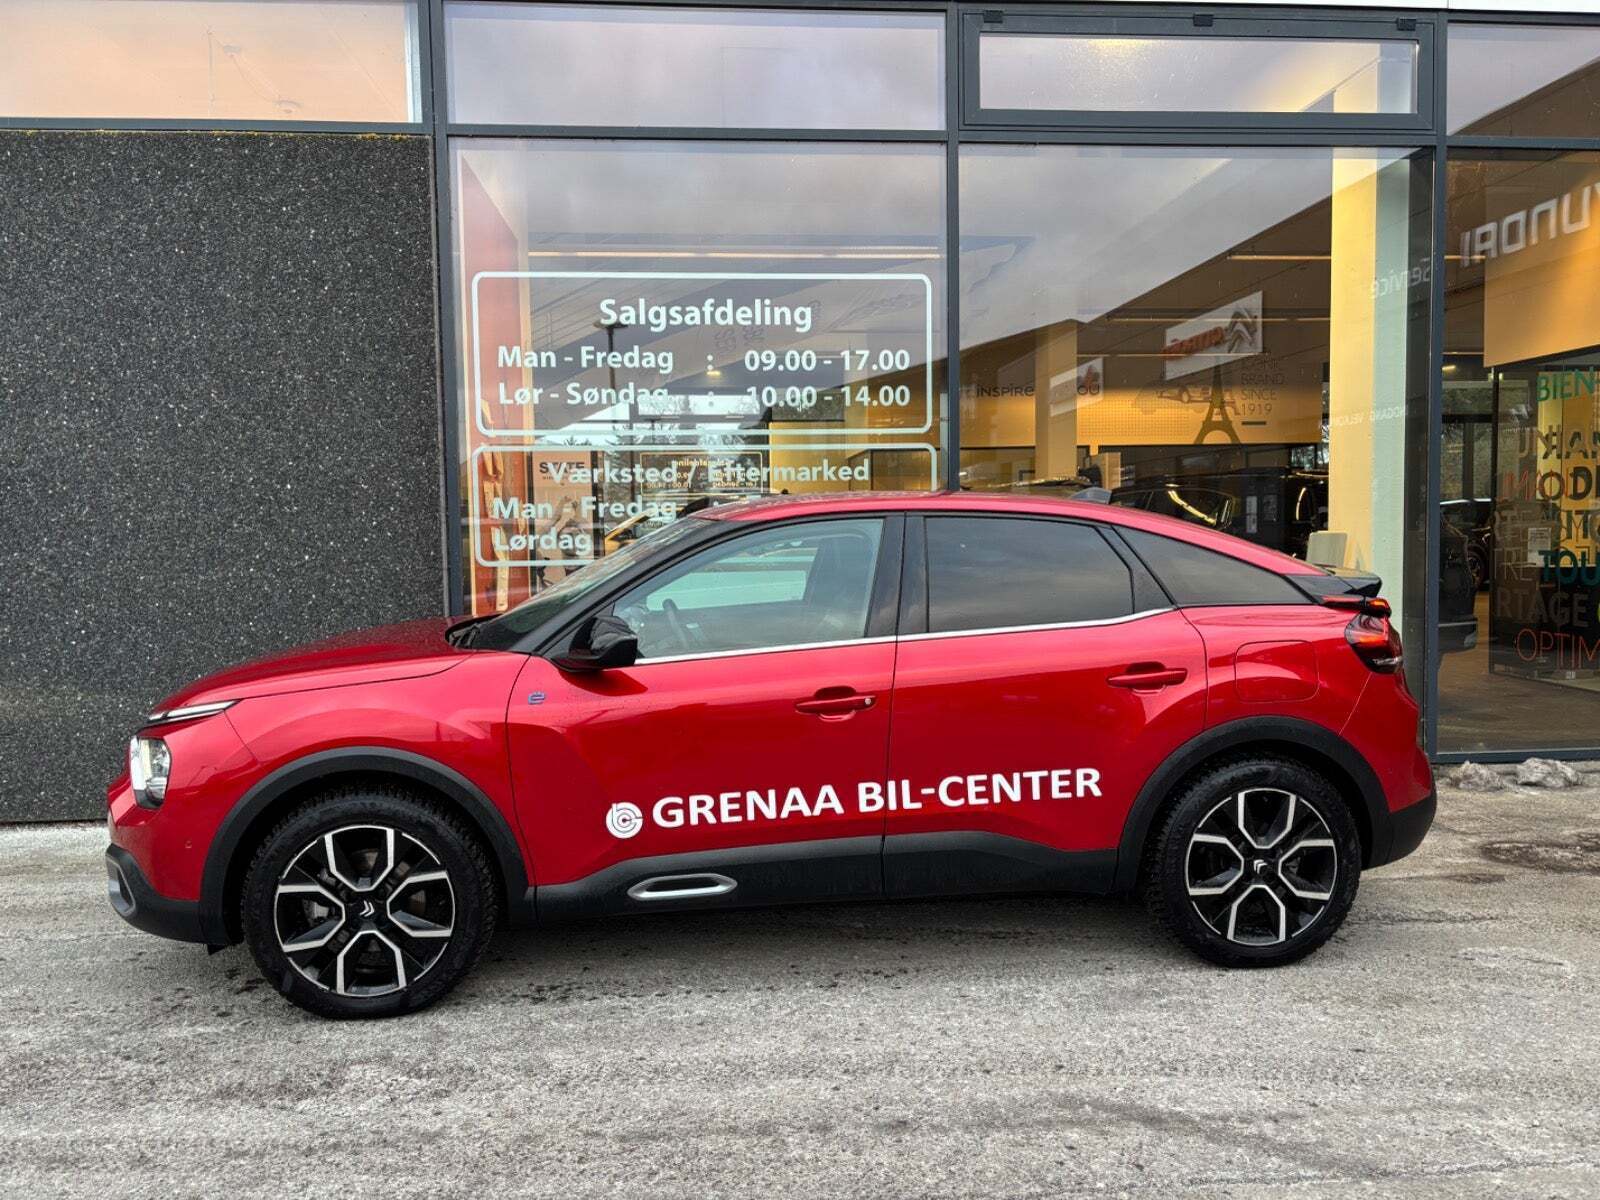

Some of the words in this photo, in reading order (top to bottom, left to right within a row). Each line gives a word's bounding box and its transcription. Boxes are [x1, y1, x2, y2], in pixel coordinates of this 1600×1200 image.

[600, 299, 812, 332] Salgsafdeling
[498, 346, 556, 368] Man
[581, 346, 673, 374] Fredag
[744, 350, 817, 371] 09.00
[840, 350, 910, 371] 17.00
[499, 383, 542, 405] Lør
[566, 383, 668, 409] Søndag
[747, 386, 817, 407] 10.00
[841, 386, 910, 407] 14.00
[1241, 388, 1277, 400] SINCE
[1241, 403, 1273, 415] 1919
[547, 461, 677, 483] Værksted
[707, 460, 869, 481] Eftermarked
[492, 497, 552, 519] Man
[581, 495, 676, 523] Fredag
[495, 528, 594, 556] Lørdag
[652, 785, 844, 829] GRENAA
[857, 766, 1103, 812] BIL-CENTER
